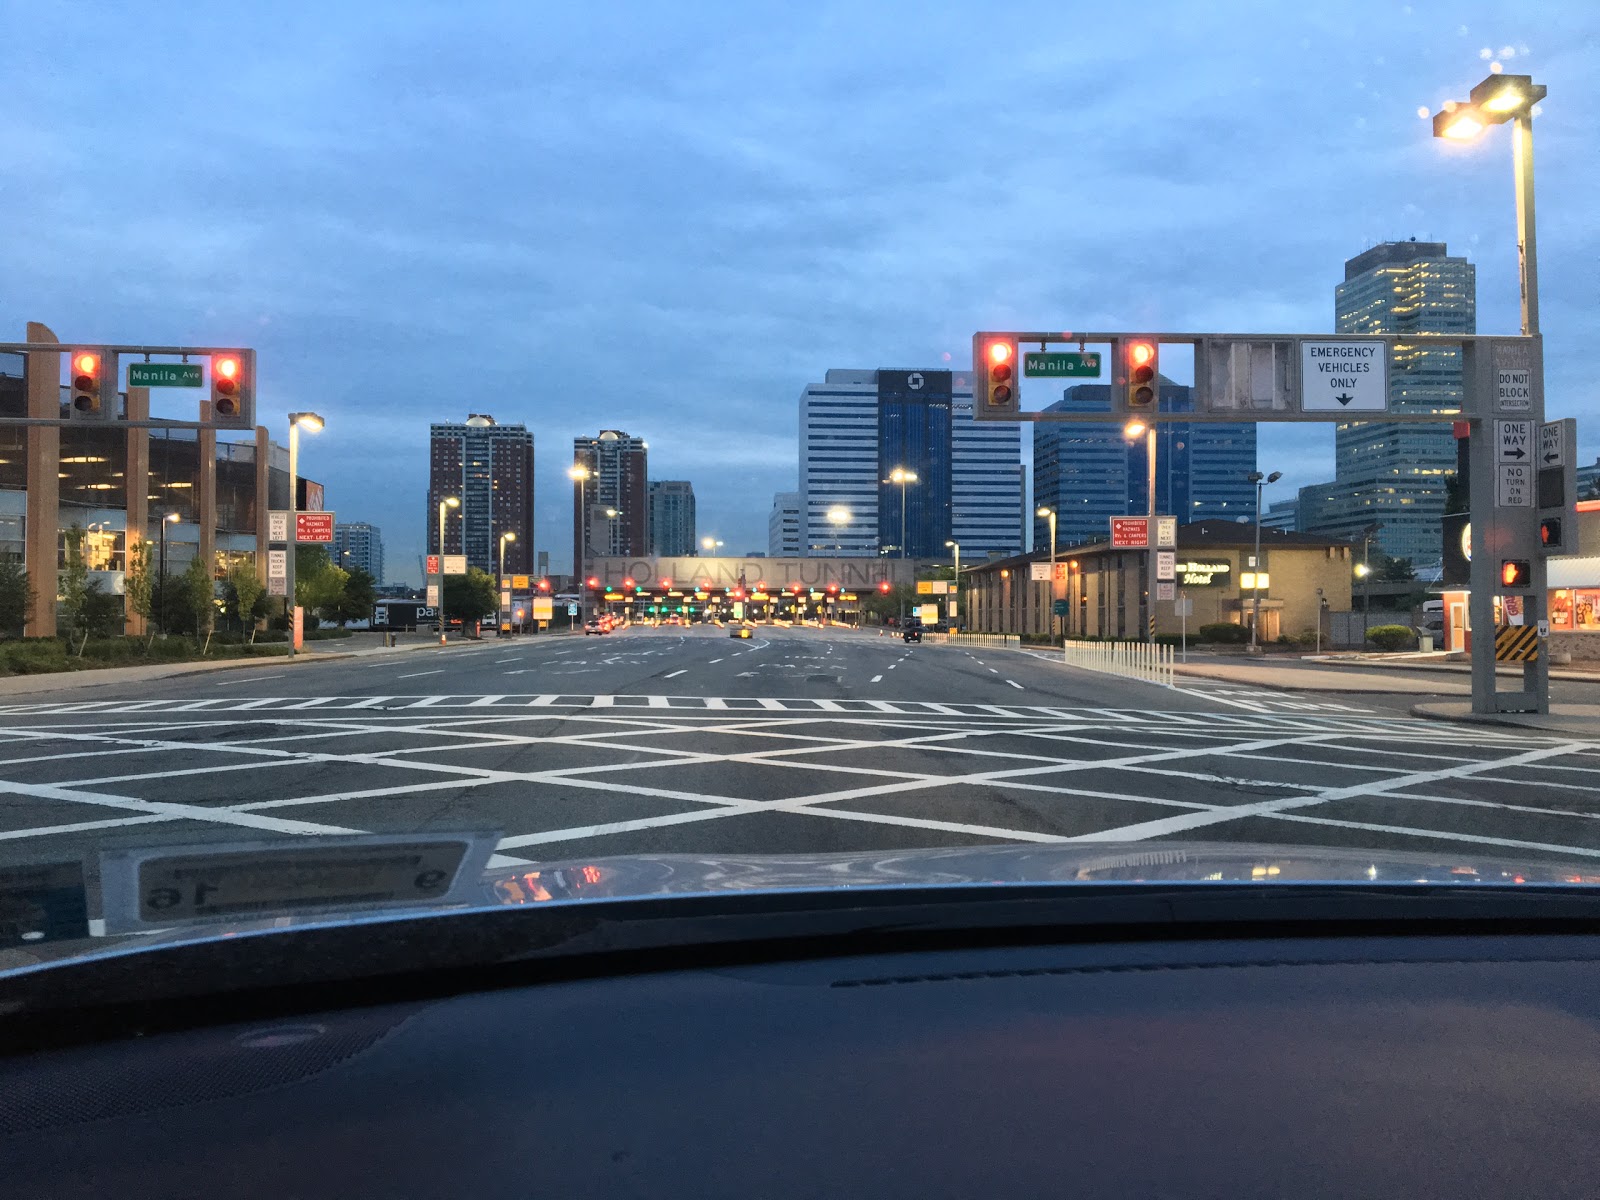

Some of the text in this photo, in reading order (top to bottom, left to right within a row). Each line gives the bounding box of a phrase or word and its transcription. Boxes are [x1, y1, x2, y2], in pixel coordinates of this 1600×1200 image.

[1311, 347, 1376, 357] EMERGENCY
[1028, 359, 1097, 371] Manila Ave
[1318, 362, 1370, 373] VEHICLES
[132, 370, 200, 381] Manila Ave
[1499, 374, 1529, 384] DO NOT
[1330, 377, 1358, 388] ONLY
[1499, 387, 1529, 398] BLOCK
[1504, 423, 1526, 434] ONE
[1542, 426, 1558, 439] ONE
[1503, 435, 1526, 446] WAY
[1542, 438, 1559, 450] WAY
[1507, 468, 1523, 477] NO
[1505, 478, 1525, 486] TURN
[1509, 487, 1521, 495] ON
[604, 562, 764, 586] HOLLAND
[1183, 572, 1214, 584] Hotel
